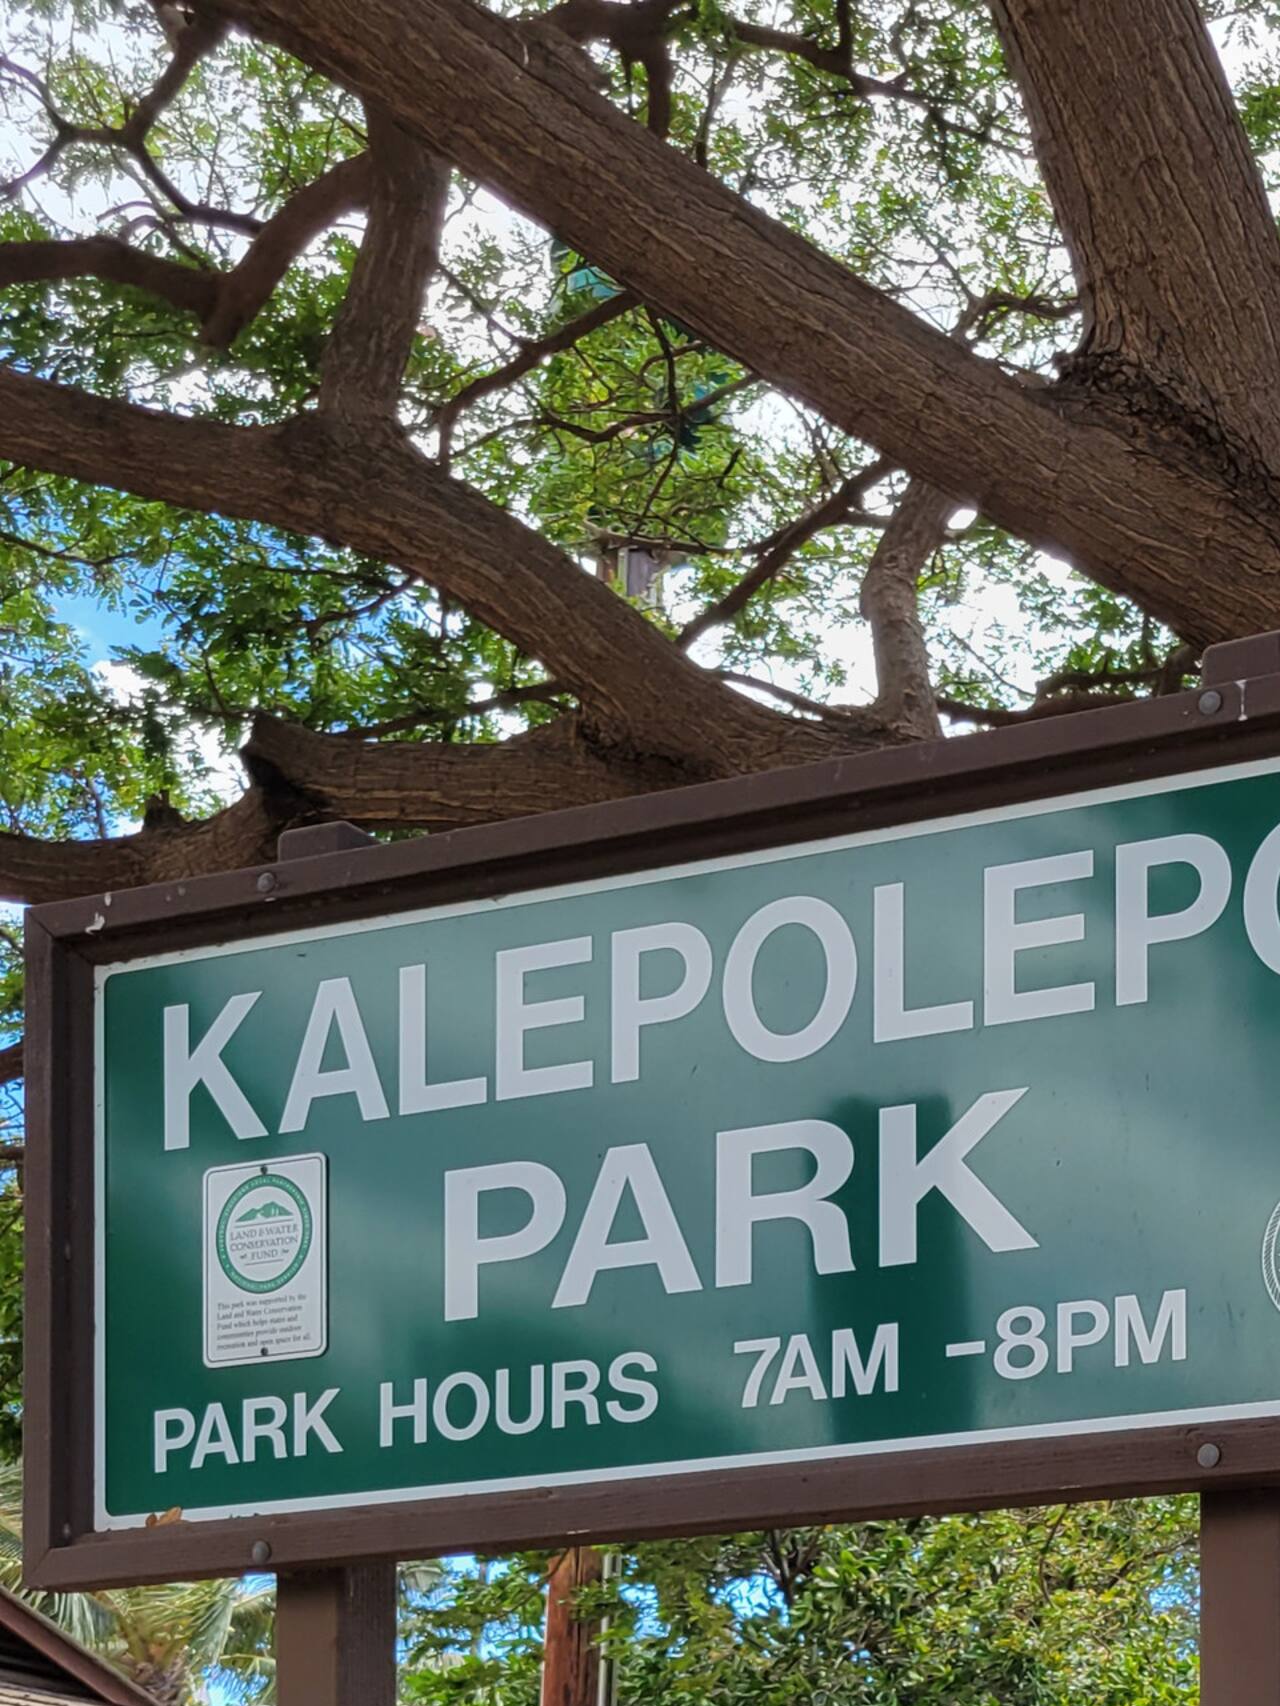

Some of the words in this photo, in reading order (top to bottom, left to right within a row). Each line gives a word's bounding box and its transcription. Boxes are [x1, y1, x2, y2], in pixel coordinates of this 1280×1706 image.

[251, 1249, 278, 1260] FUND
[444, 1086, 1040, 1322] PARK
[154, 1388, 344, 1473] PARK
[380, 1351, 658, 1447] HOURS
[733, 1322, 899, 1409] 7AM
